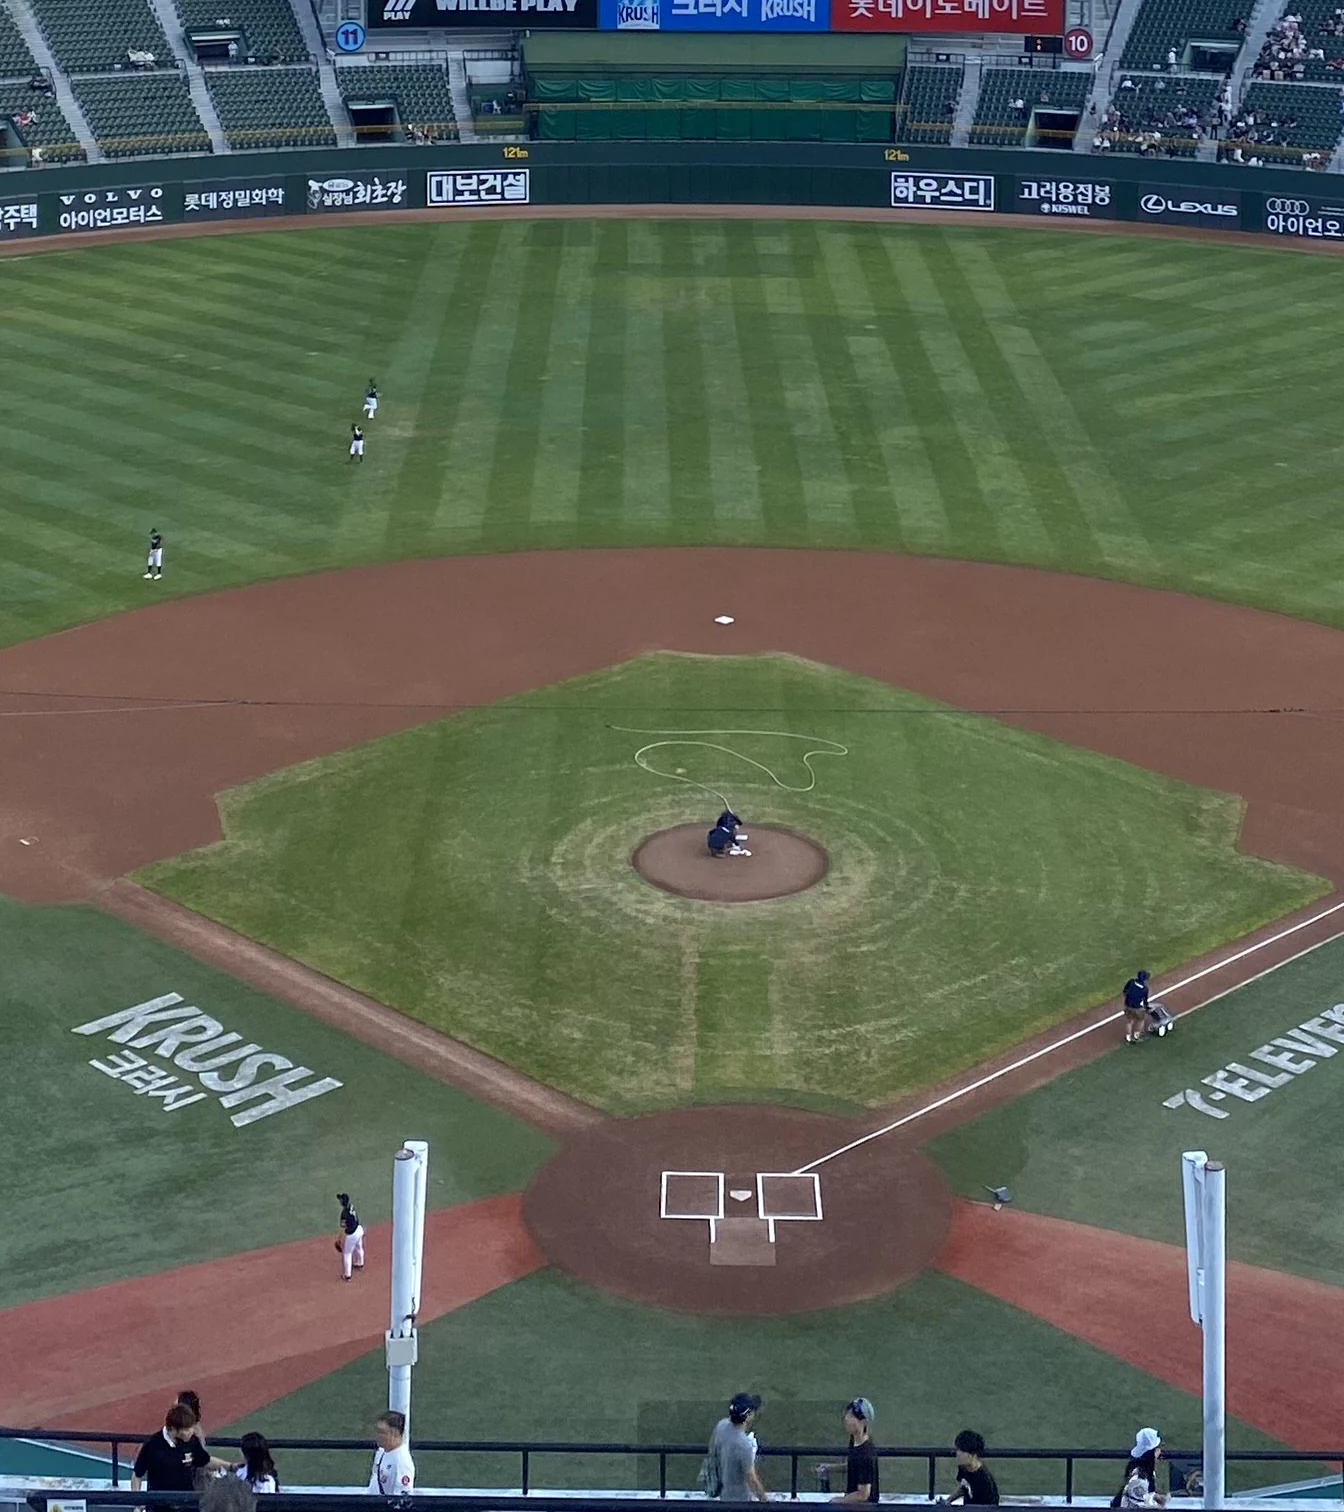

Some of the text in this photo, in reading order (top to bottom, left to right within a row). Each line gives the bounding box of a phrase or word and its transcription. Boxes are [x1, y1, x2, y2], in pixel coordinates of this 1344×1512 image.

[383, 11, 410, 20] PLAY
[617, 3, 659, 25] KRUSH
[341, 29, 359, 45] 11
[1068, 36, 1088, 52] 10
[503, 147, 528, 159] 121m
[884, 149, 909, 162] 121m
[60, 187, 164, 206] VOLVO
[431, 173, 526, 202] 대보건설
[894, 176, 985, 206] 하우스디
[1018, 181, 1111, 206] 고려용접봉
[184, 187, 285, 212] 롯데정밀화학
[322, 191, 353, 206] 실장님
[60, 204, 163, 230] 아이언모터스
[1052, 203, 1090, 215] KISWEL
[1168, 201, 1238, 217] LEXUS
[70, 991, 344, 1128] KRUSH
[89, 1049, 208, 1112] 크러시
